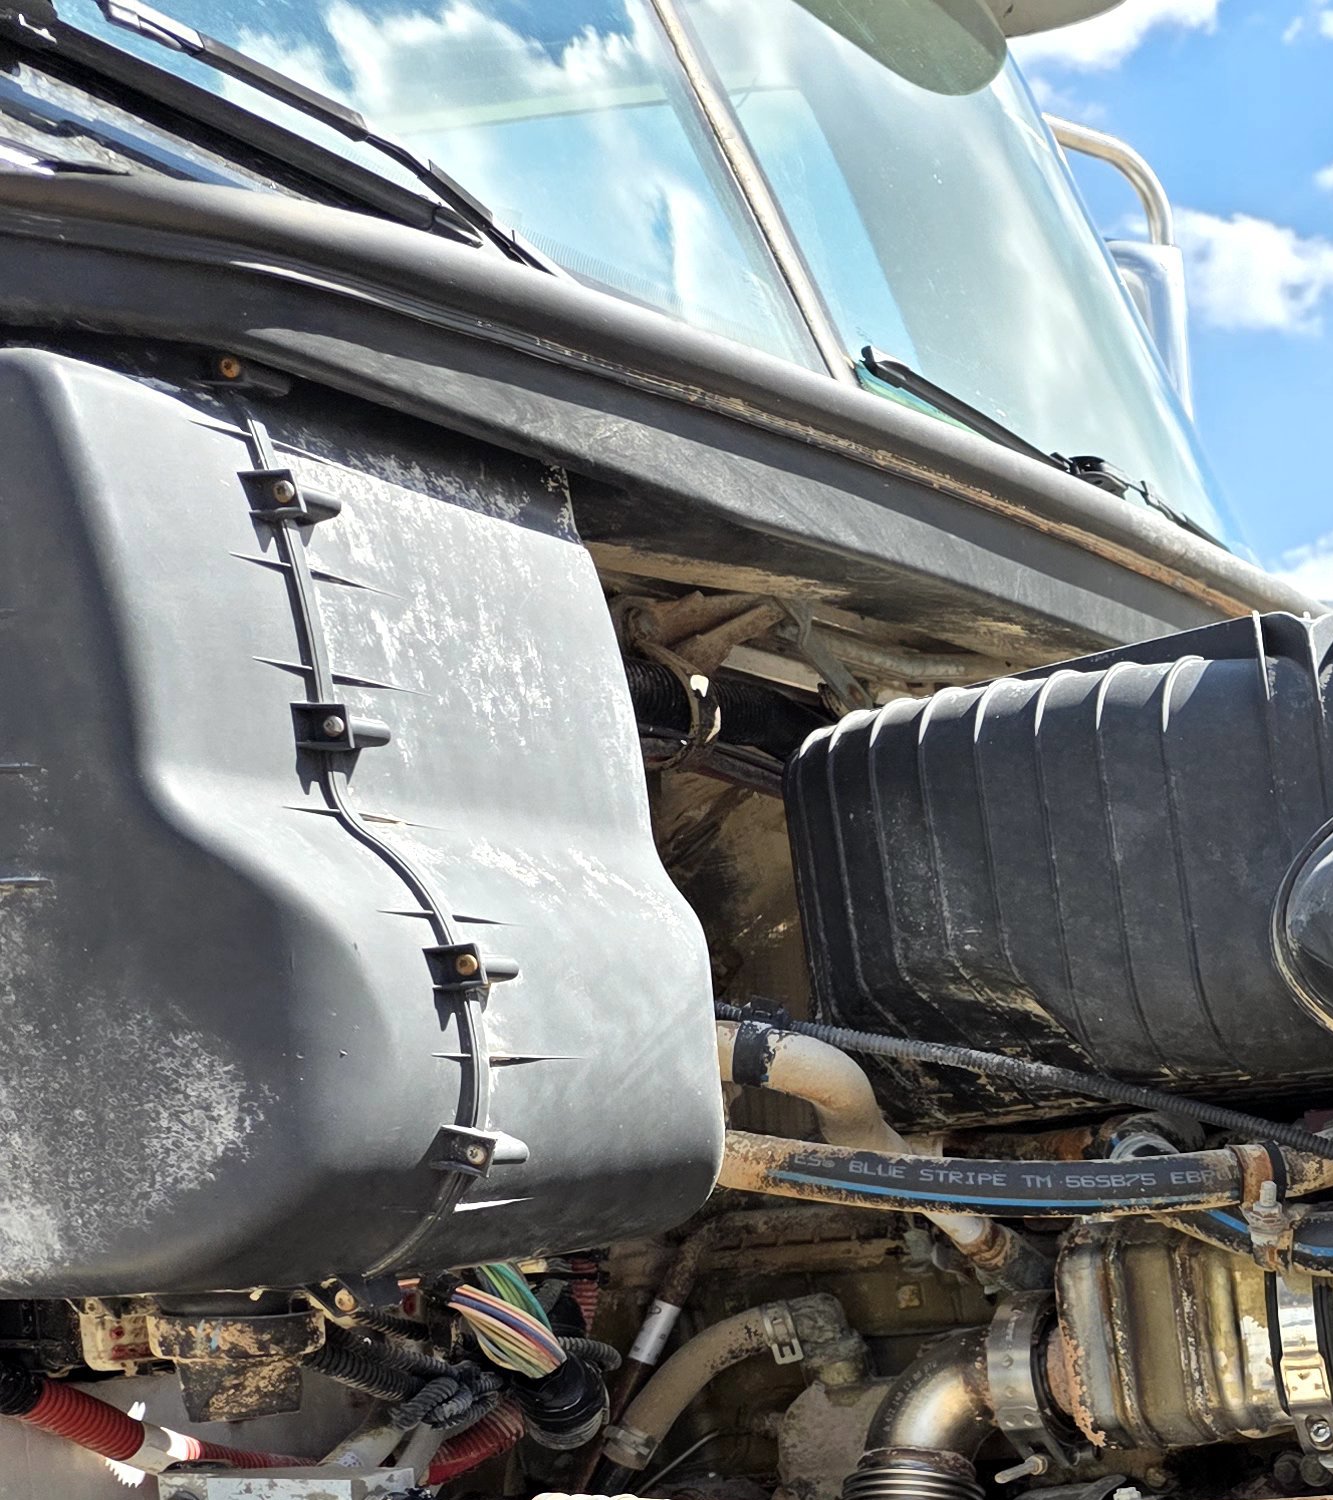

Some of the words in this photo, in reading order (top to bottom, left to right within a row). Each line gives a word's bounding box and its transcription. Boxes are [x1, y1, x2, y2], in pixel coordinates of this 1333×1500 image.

[849, 1160, 906, 1179] BLUE
[919, 1168, 1007, 1187] STRIPE
[1021, 1173, 1051, 1188] TM
